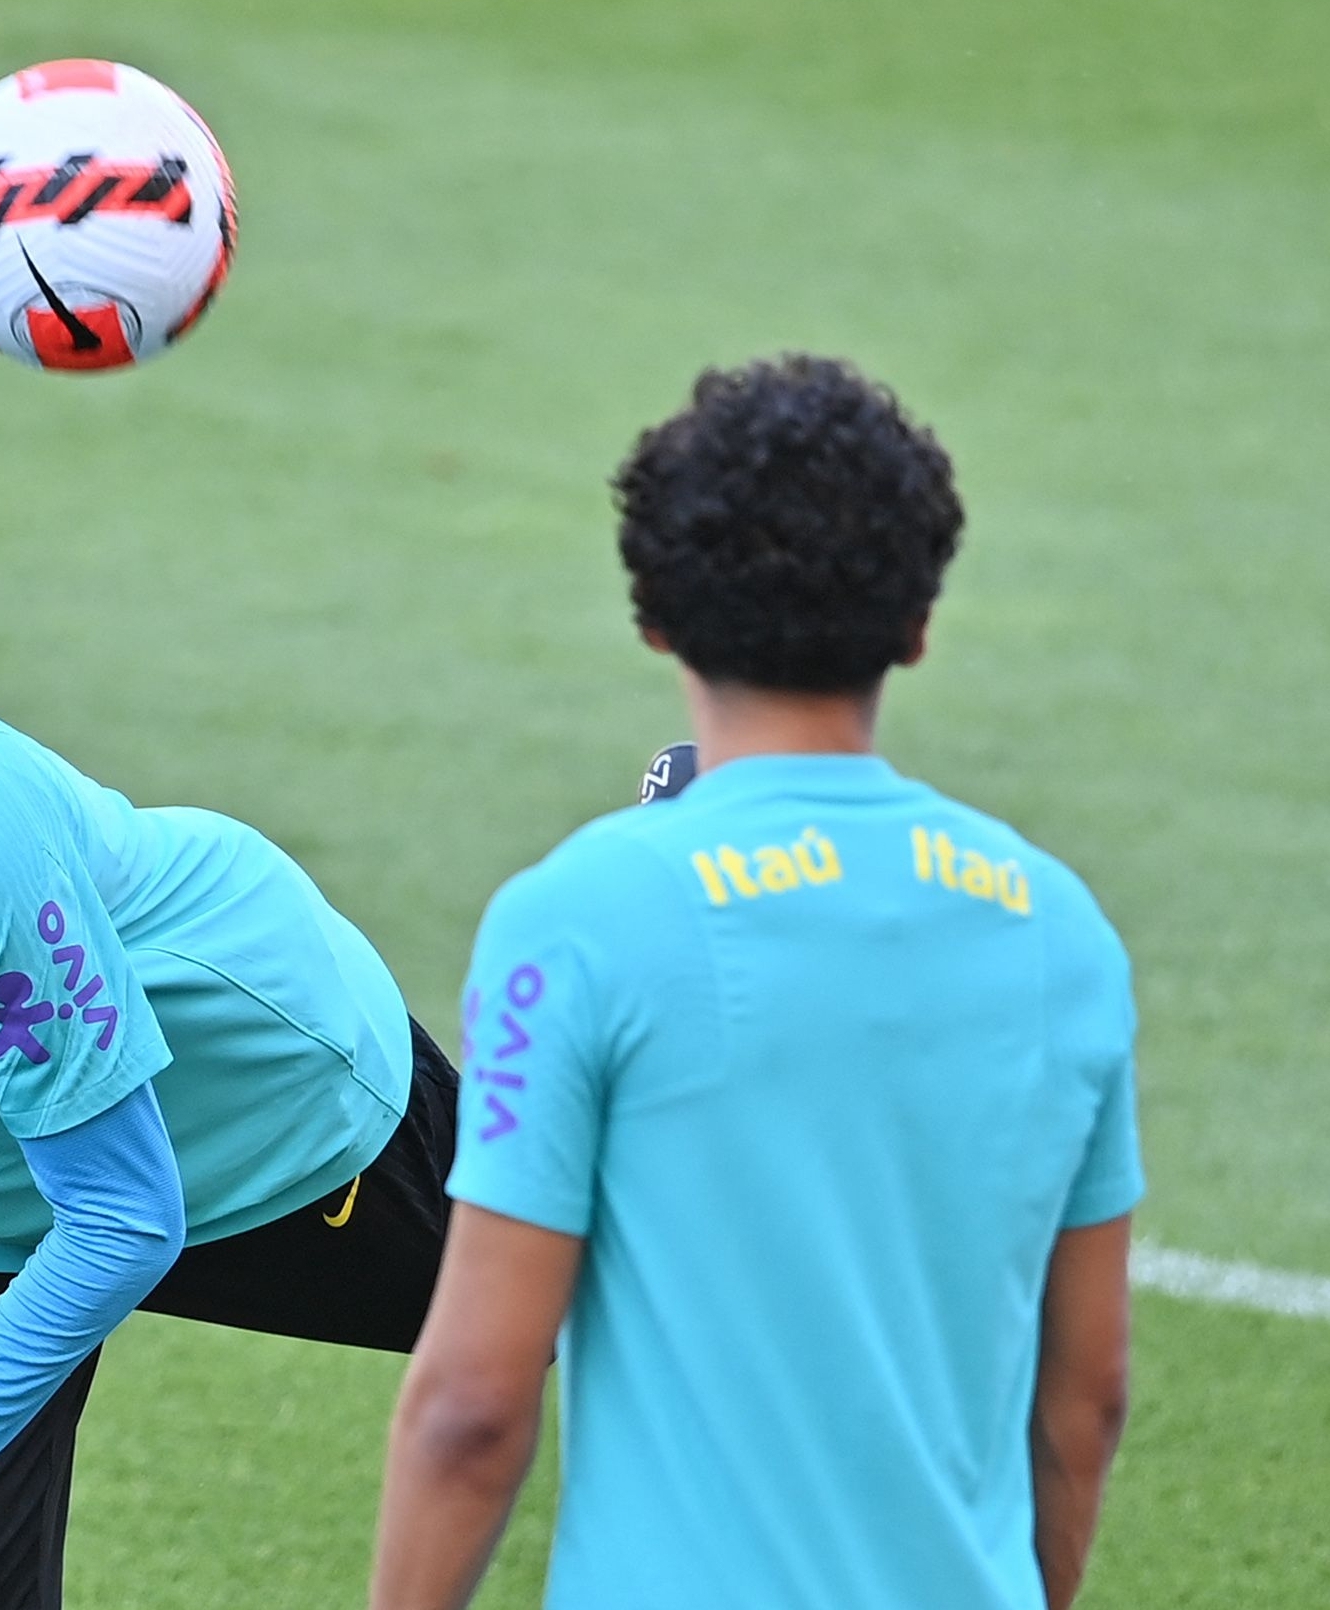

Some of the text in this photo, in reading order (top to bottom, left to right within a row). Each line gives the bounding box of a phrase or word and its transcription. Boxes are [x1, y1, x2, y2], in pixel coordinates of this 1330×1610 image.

[692, 826, 1031, 915] Itaú Itaú
[37, 900, 118, 1051] vivo
[479, 963, 545, 1142] vivo
